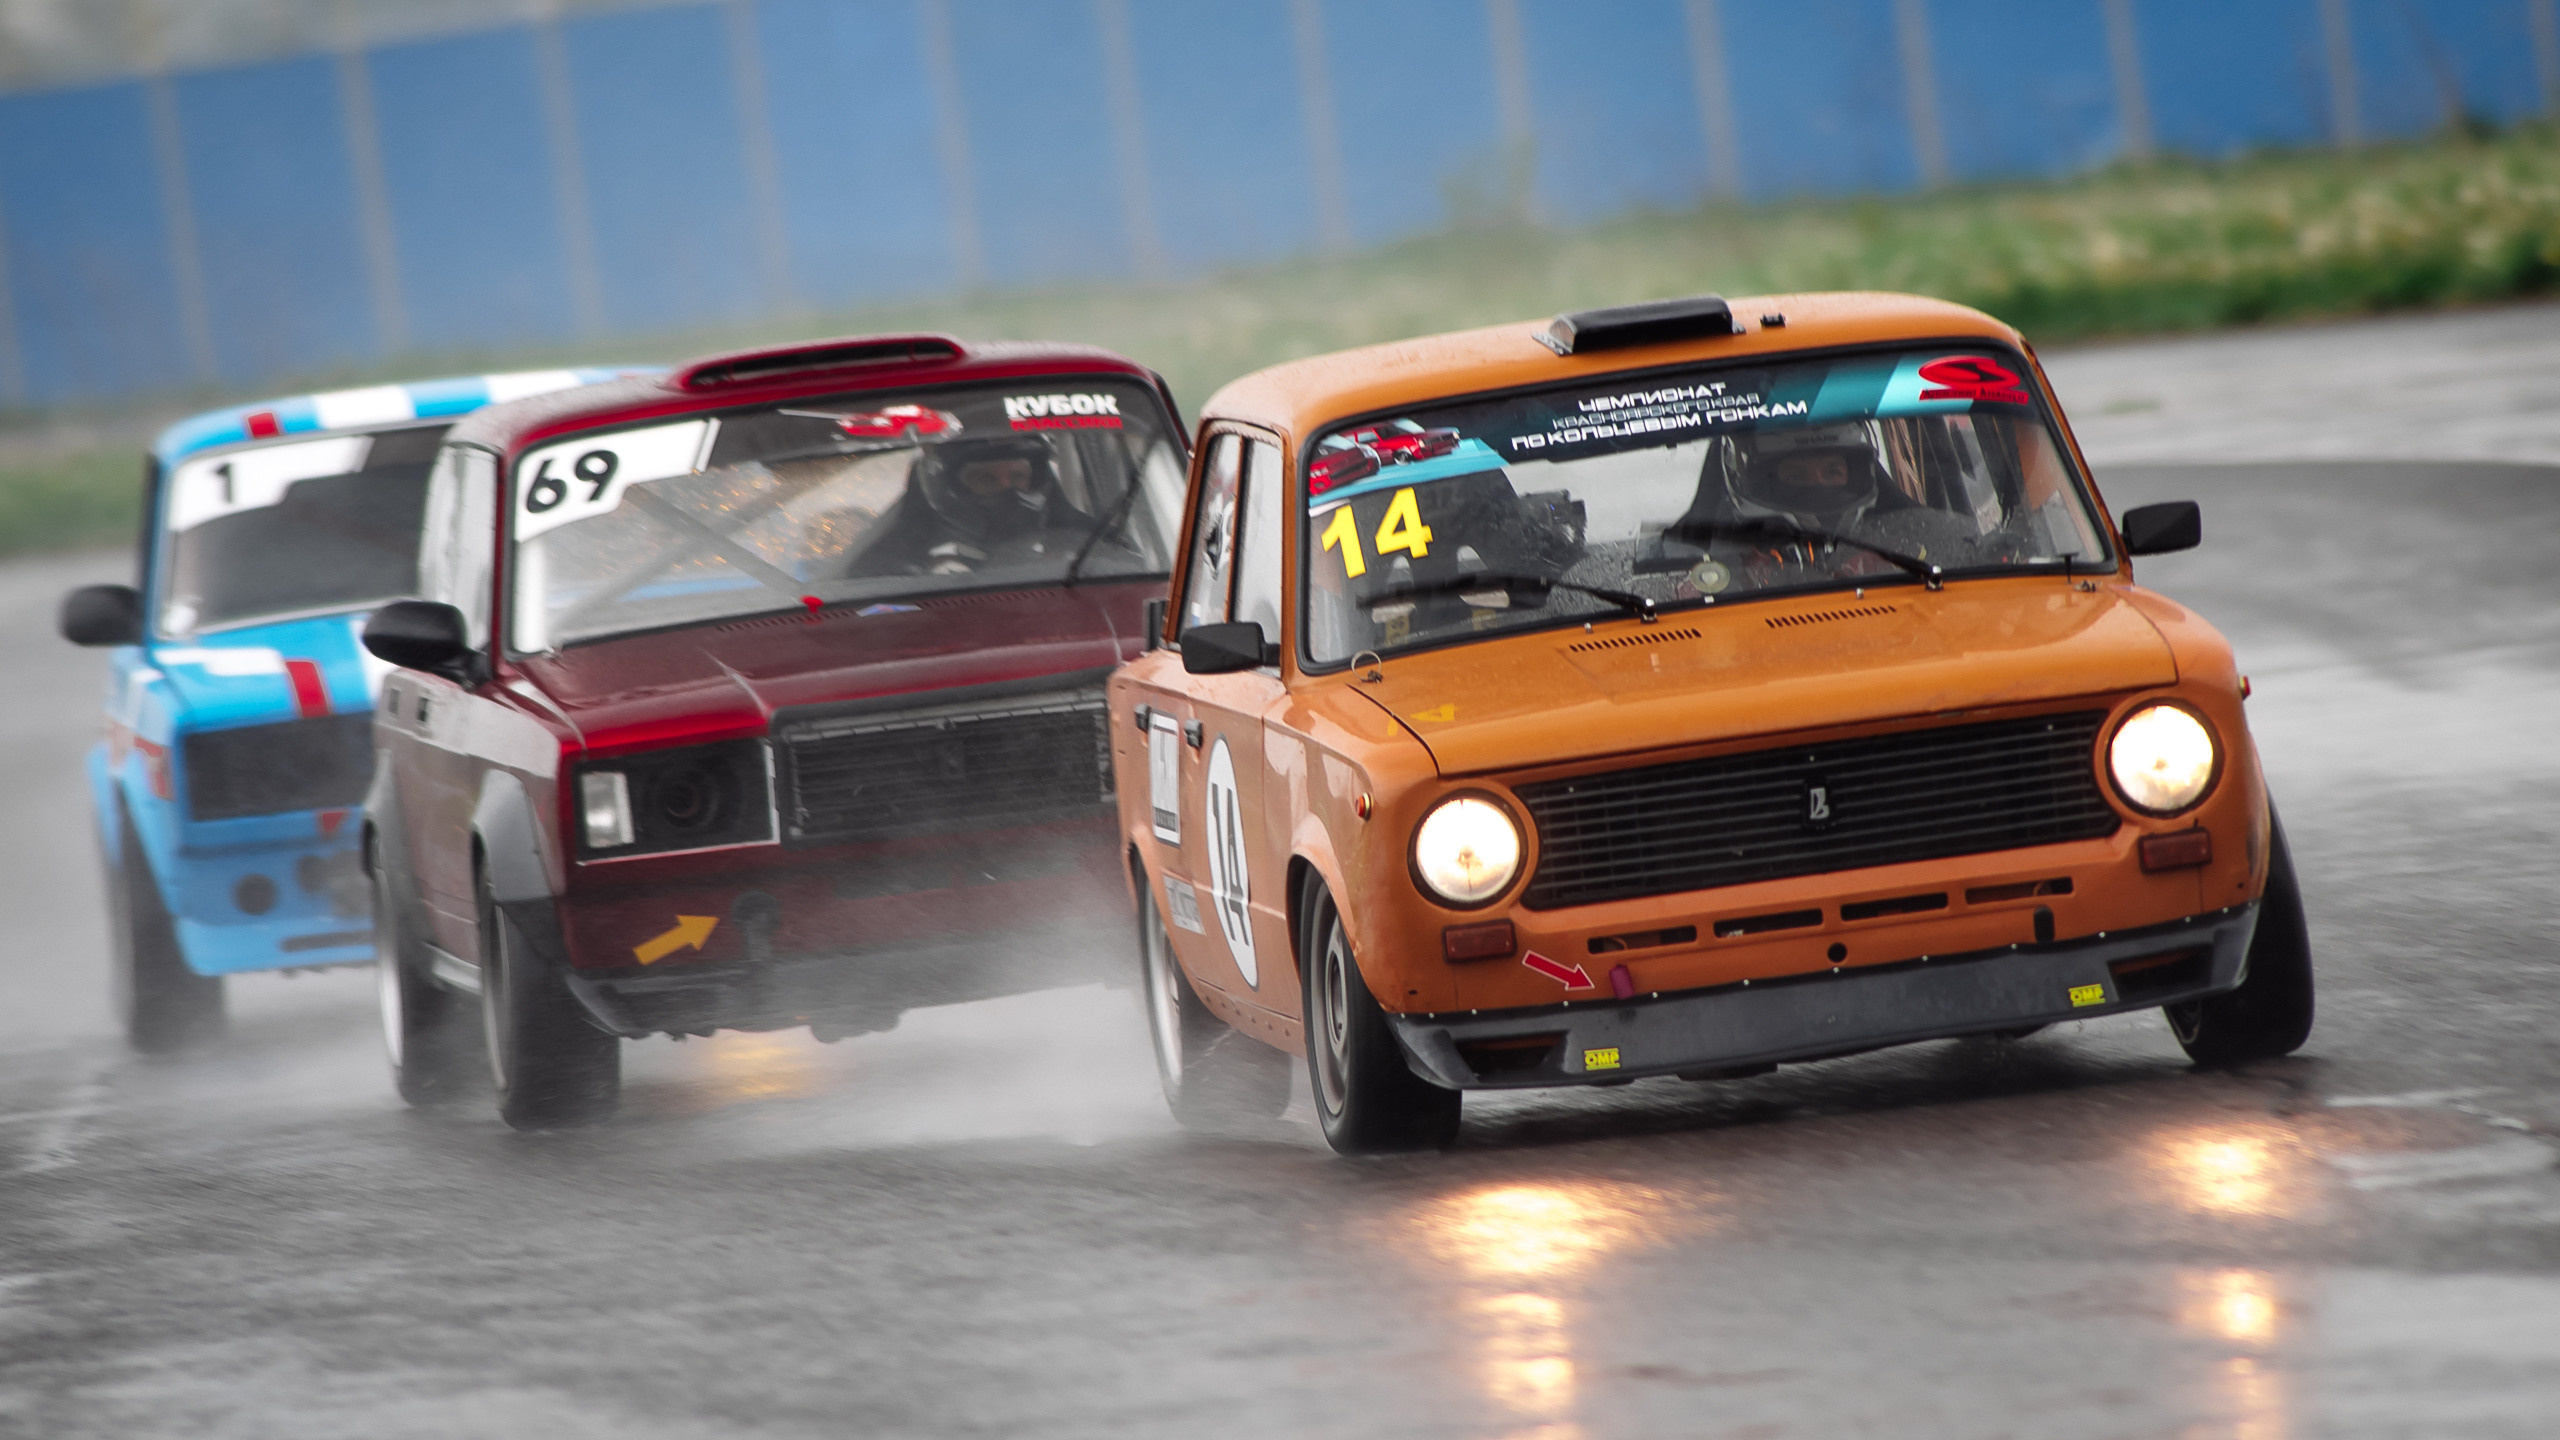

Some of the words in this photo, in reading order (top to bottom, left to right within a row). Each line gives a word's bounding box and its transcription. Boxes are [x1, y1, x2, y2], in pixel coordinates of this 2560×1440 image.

[1003, 394, 1120, 420] КУБОК
[1578, 381, 1726, 412] ЧЕМПИОНАТ
[1511, 433, 1546, 451] ПО
[1547, 412, 1701, 446] КОЛЬЦЕВЫМ
[1706, 400, 1808, 425] ГОНКАМ
[213, 463, 236, 503] 1
[526, 450, 619, 514] 69
[1321, 488, 1433, 578] 14
[1211, 783, 1250, 946] 14
[2070, 987, 2104, 1003] OMP
[1585, 1051, 1620, 1067] OMP
